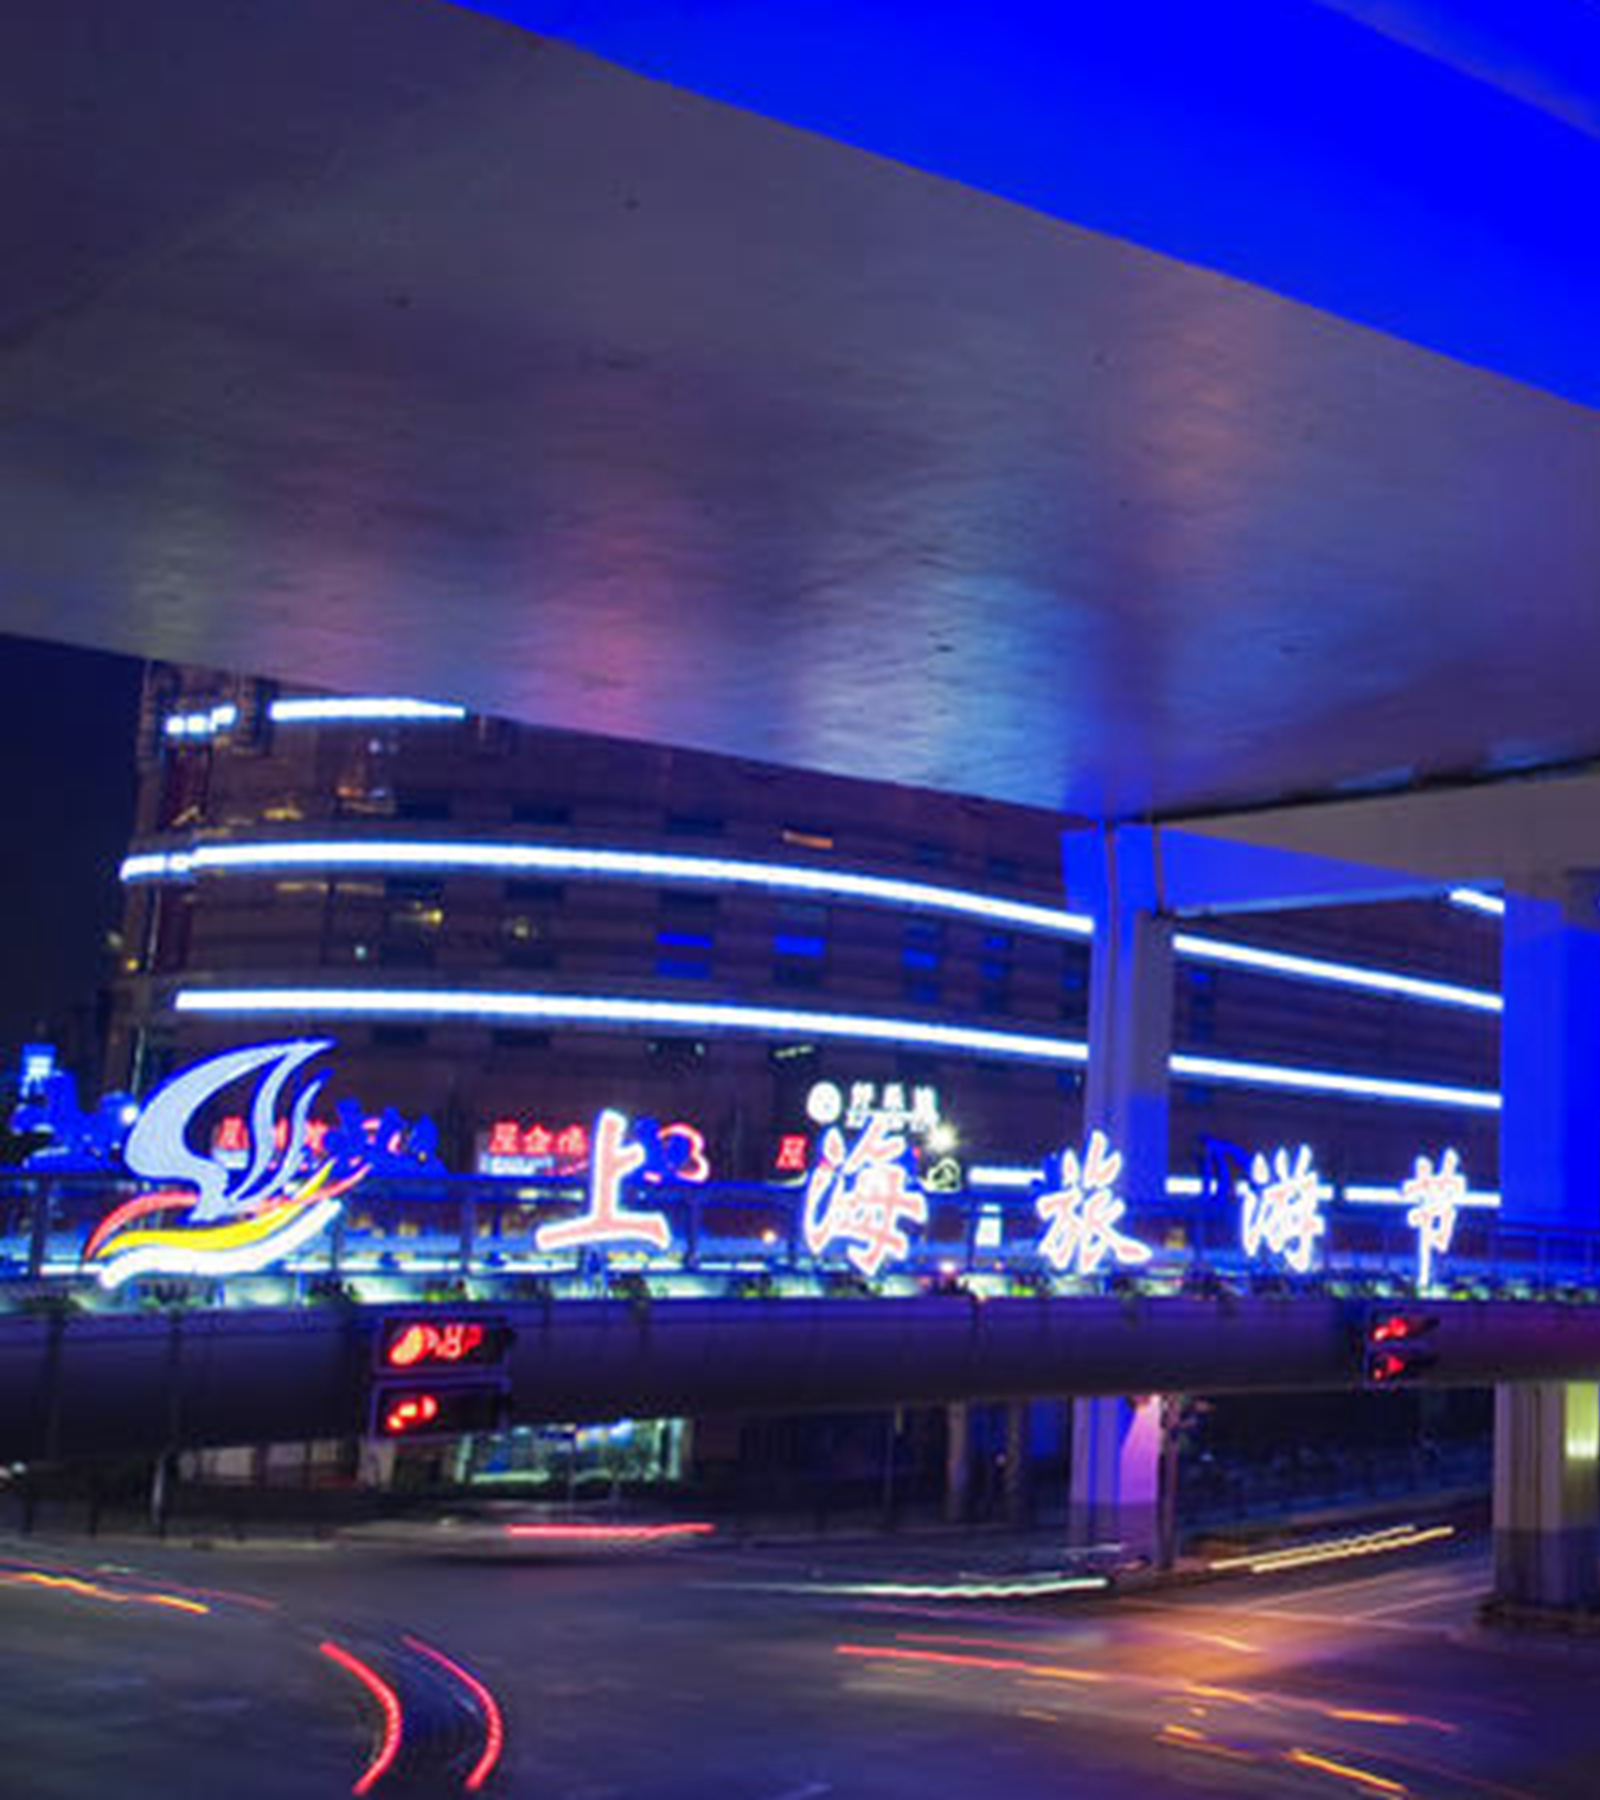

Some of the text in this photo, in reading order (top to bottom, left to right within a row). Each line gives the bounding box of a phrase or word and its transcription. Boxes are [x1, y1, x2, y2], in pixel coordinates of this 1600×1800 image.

[535, 1107, 1467, 1288] 上海旅游节
